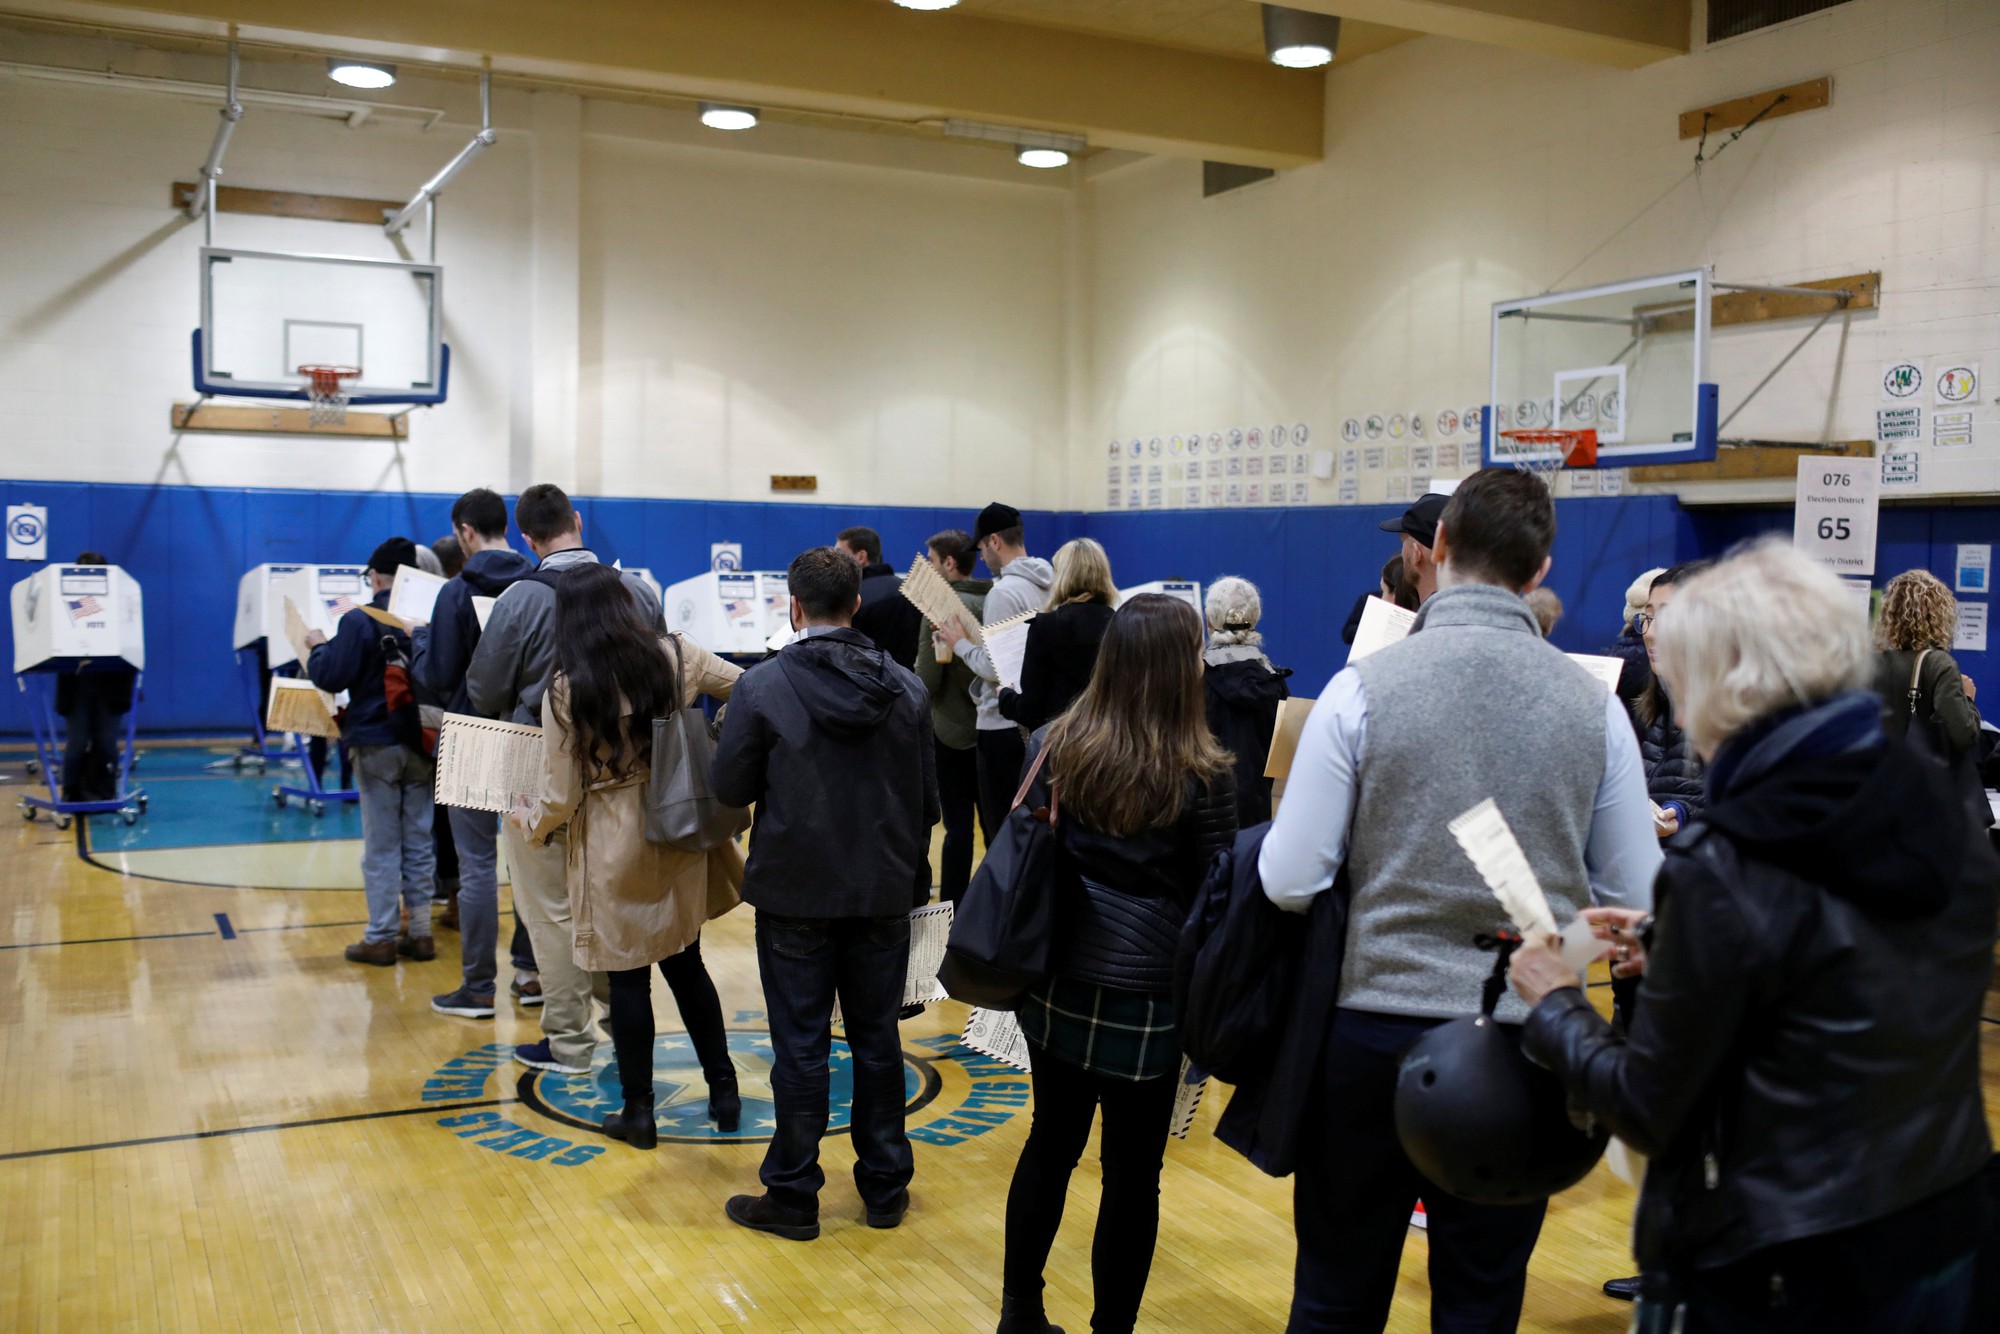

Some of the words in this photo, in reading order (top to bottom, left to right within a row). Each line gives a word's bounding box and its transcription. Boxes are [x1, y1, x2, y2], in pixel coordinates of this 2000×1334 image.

[1822, 473, 1851, 487] 076
[1806, 494, 1837, 504] Election
[1838, 495, 1865, 505] District
[1817, 516, 1851, 541] 65
[1837, 557, 1864, 566] District
[904, 1081, 1030, 1147] SILVER
[436, 1111, 606, 1167] STARS
